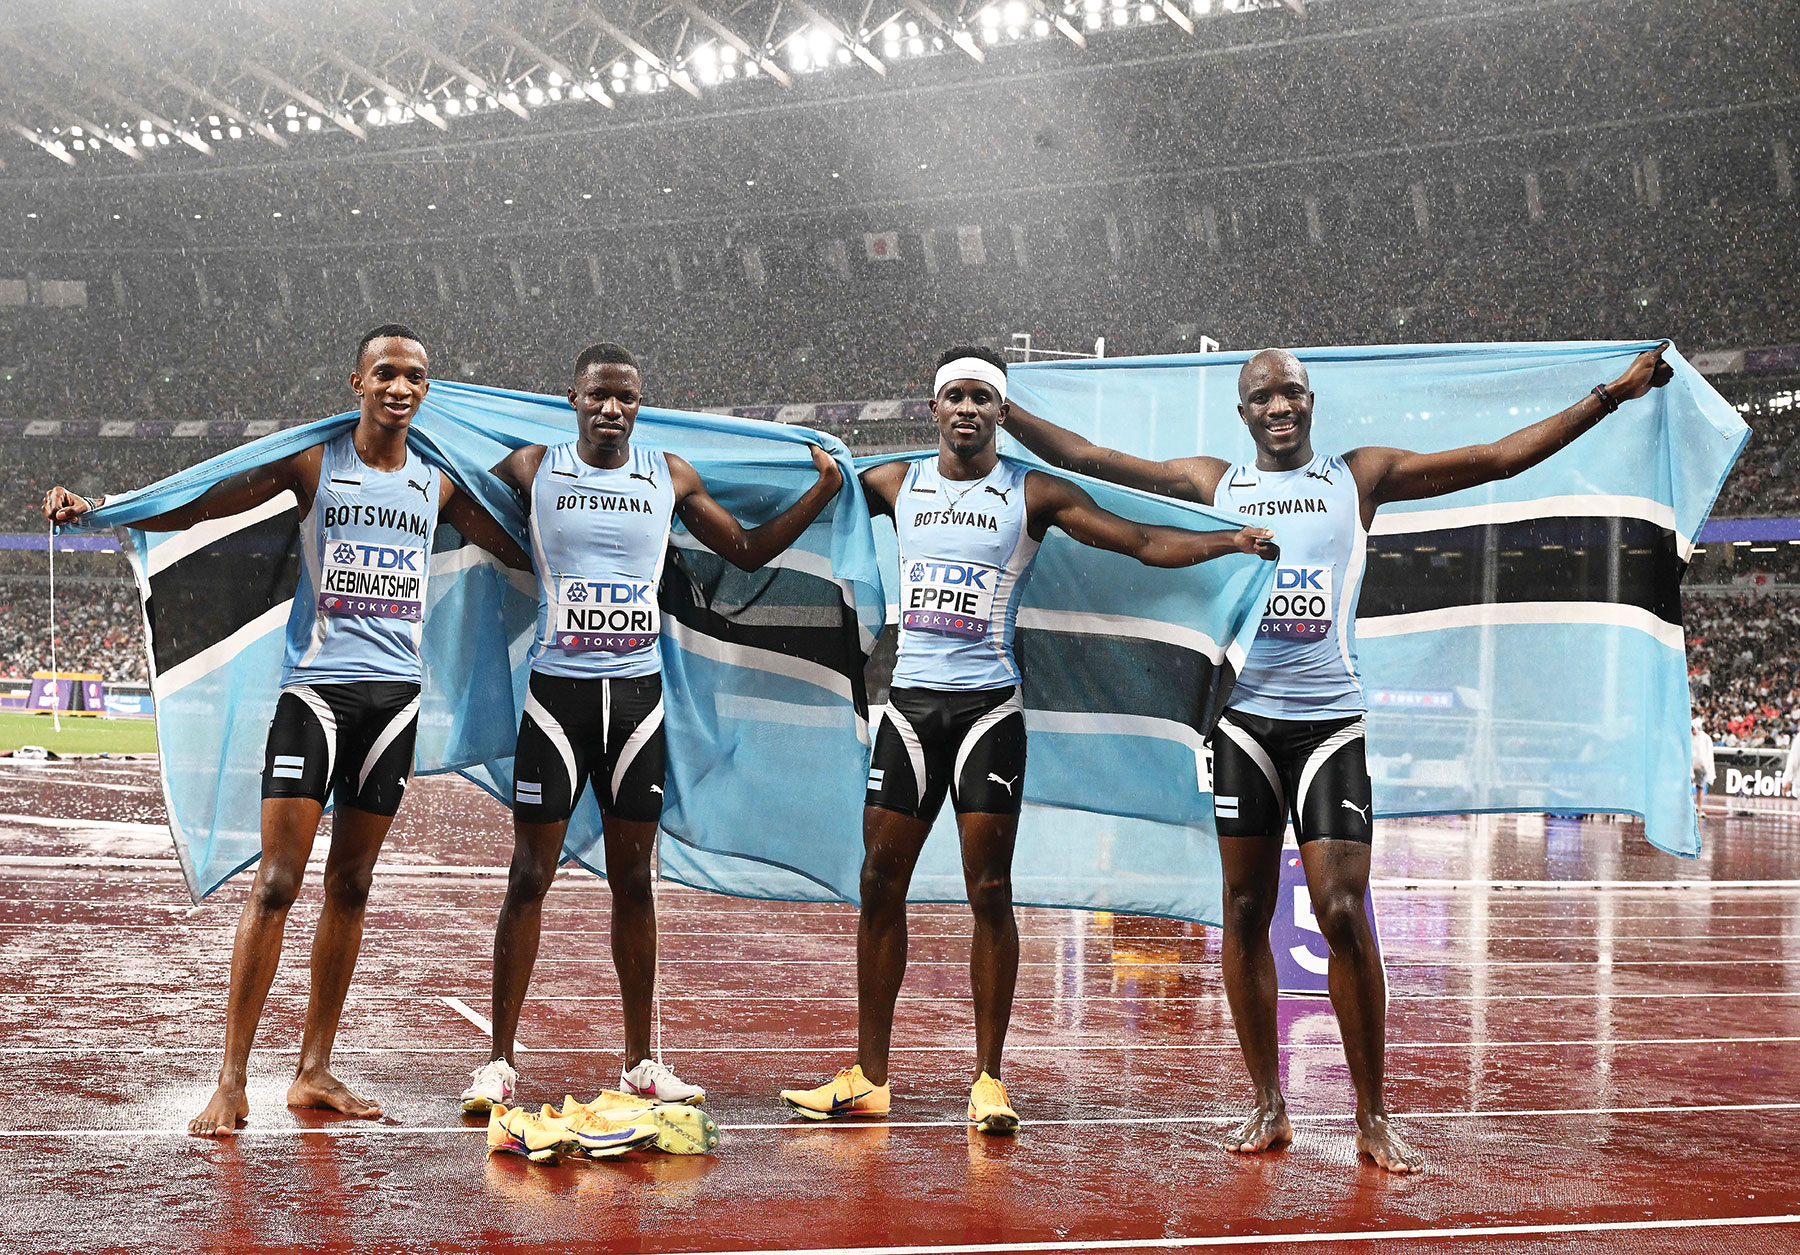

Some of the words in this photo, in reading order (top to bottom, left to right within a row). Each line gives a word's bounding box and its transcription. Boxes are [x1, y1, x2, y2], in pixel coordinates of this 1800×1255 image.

[557, 495, 653, 515] BOTSWANA
[325, 505, 428, 539] BOTSWANA
[913, 510, 998, 531] BOTSWANA
[355, 544, 417, 571] TDK
[325, 568, 420, 599] KEBINATSHIPI
[926, 562, 989, 590] TDK
[1276, 568, 1324, 590] DK
[587, 582, 651, 605] TDK
[910, 587, 979, 615] EPPIE
[1262, 594, 1326, 618] BOGO
[566, 608, 652, 632] NDORI
[1726, 768, 1793, 797] Deloi
